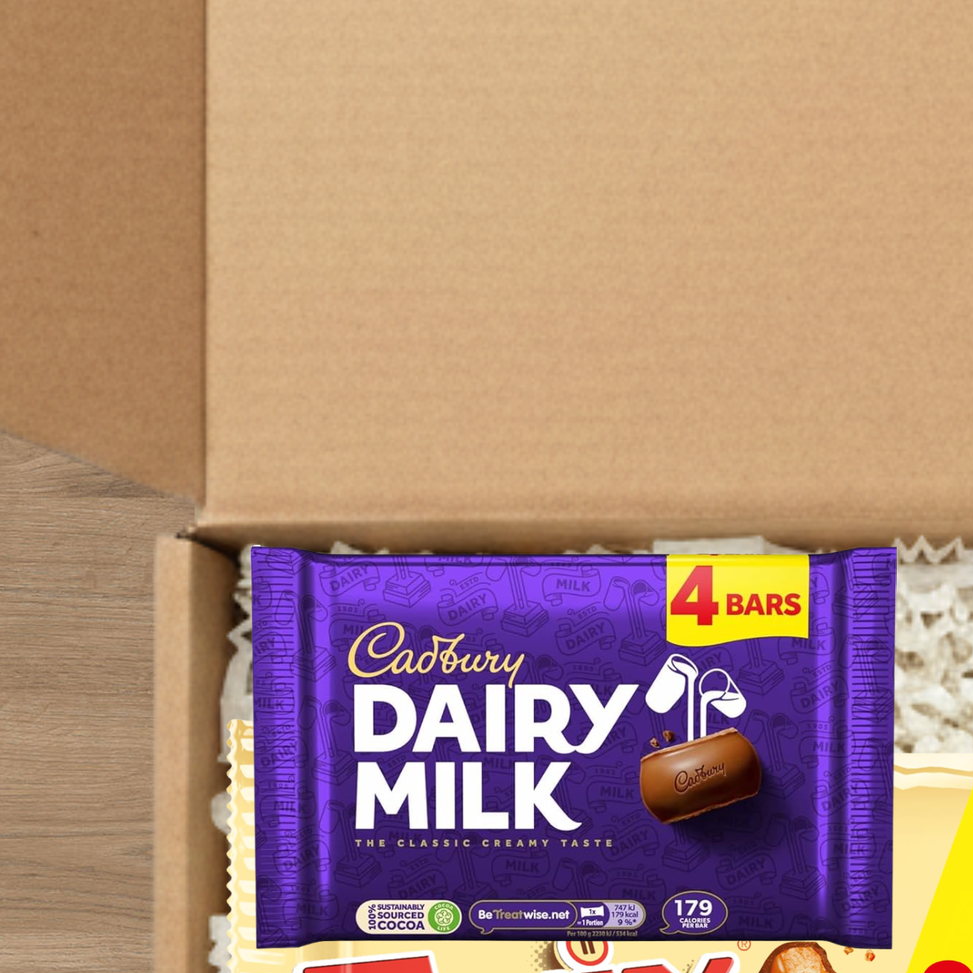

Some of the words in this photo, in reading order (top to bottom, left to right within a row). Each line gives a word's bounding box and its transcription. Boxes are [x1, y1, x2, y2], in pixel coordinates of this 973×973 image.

[556, 578, 592, 592] MILK
[670, 565, 719, 626] 4
[726, 594, 801, 616] BARS
[448, 594, 488, 621] DAIRY
[565, 622, 606, 650] DAIRY
[347, 621, 526, 688] Cadbury
[354, 684, 640, 754] DAIRY
[674, 762, 726, 794] Cadbury
[354, 762, 583, 832] MILK
[600, 785, 635, 799] MILK
[354, 839, 386, 848] THE
[397, 839, 471, 848] CLASSIC
[482, 839, 550, 848] CREAMY
[561, 839, 613, 848] TASTE
[368, 904, 376, 930] 100%
[377, 912, 425, 920] SOURCED
[674, 900, 713, 916] 179
[377, 920, 425, 930] COCOA
